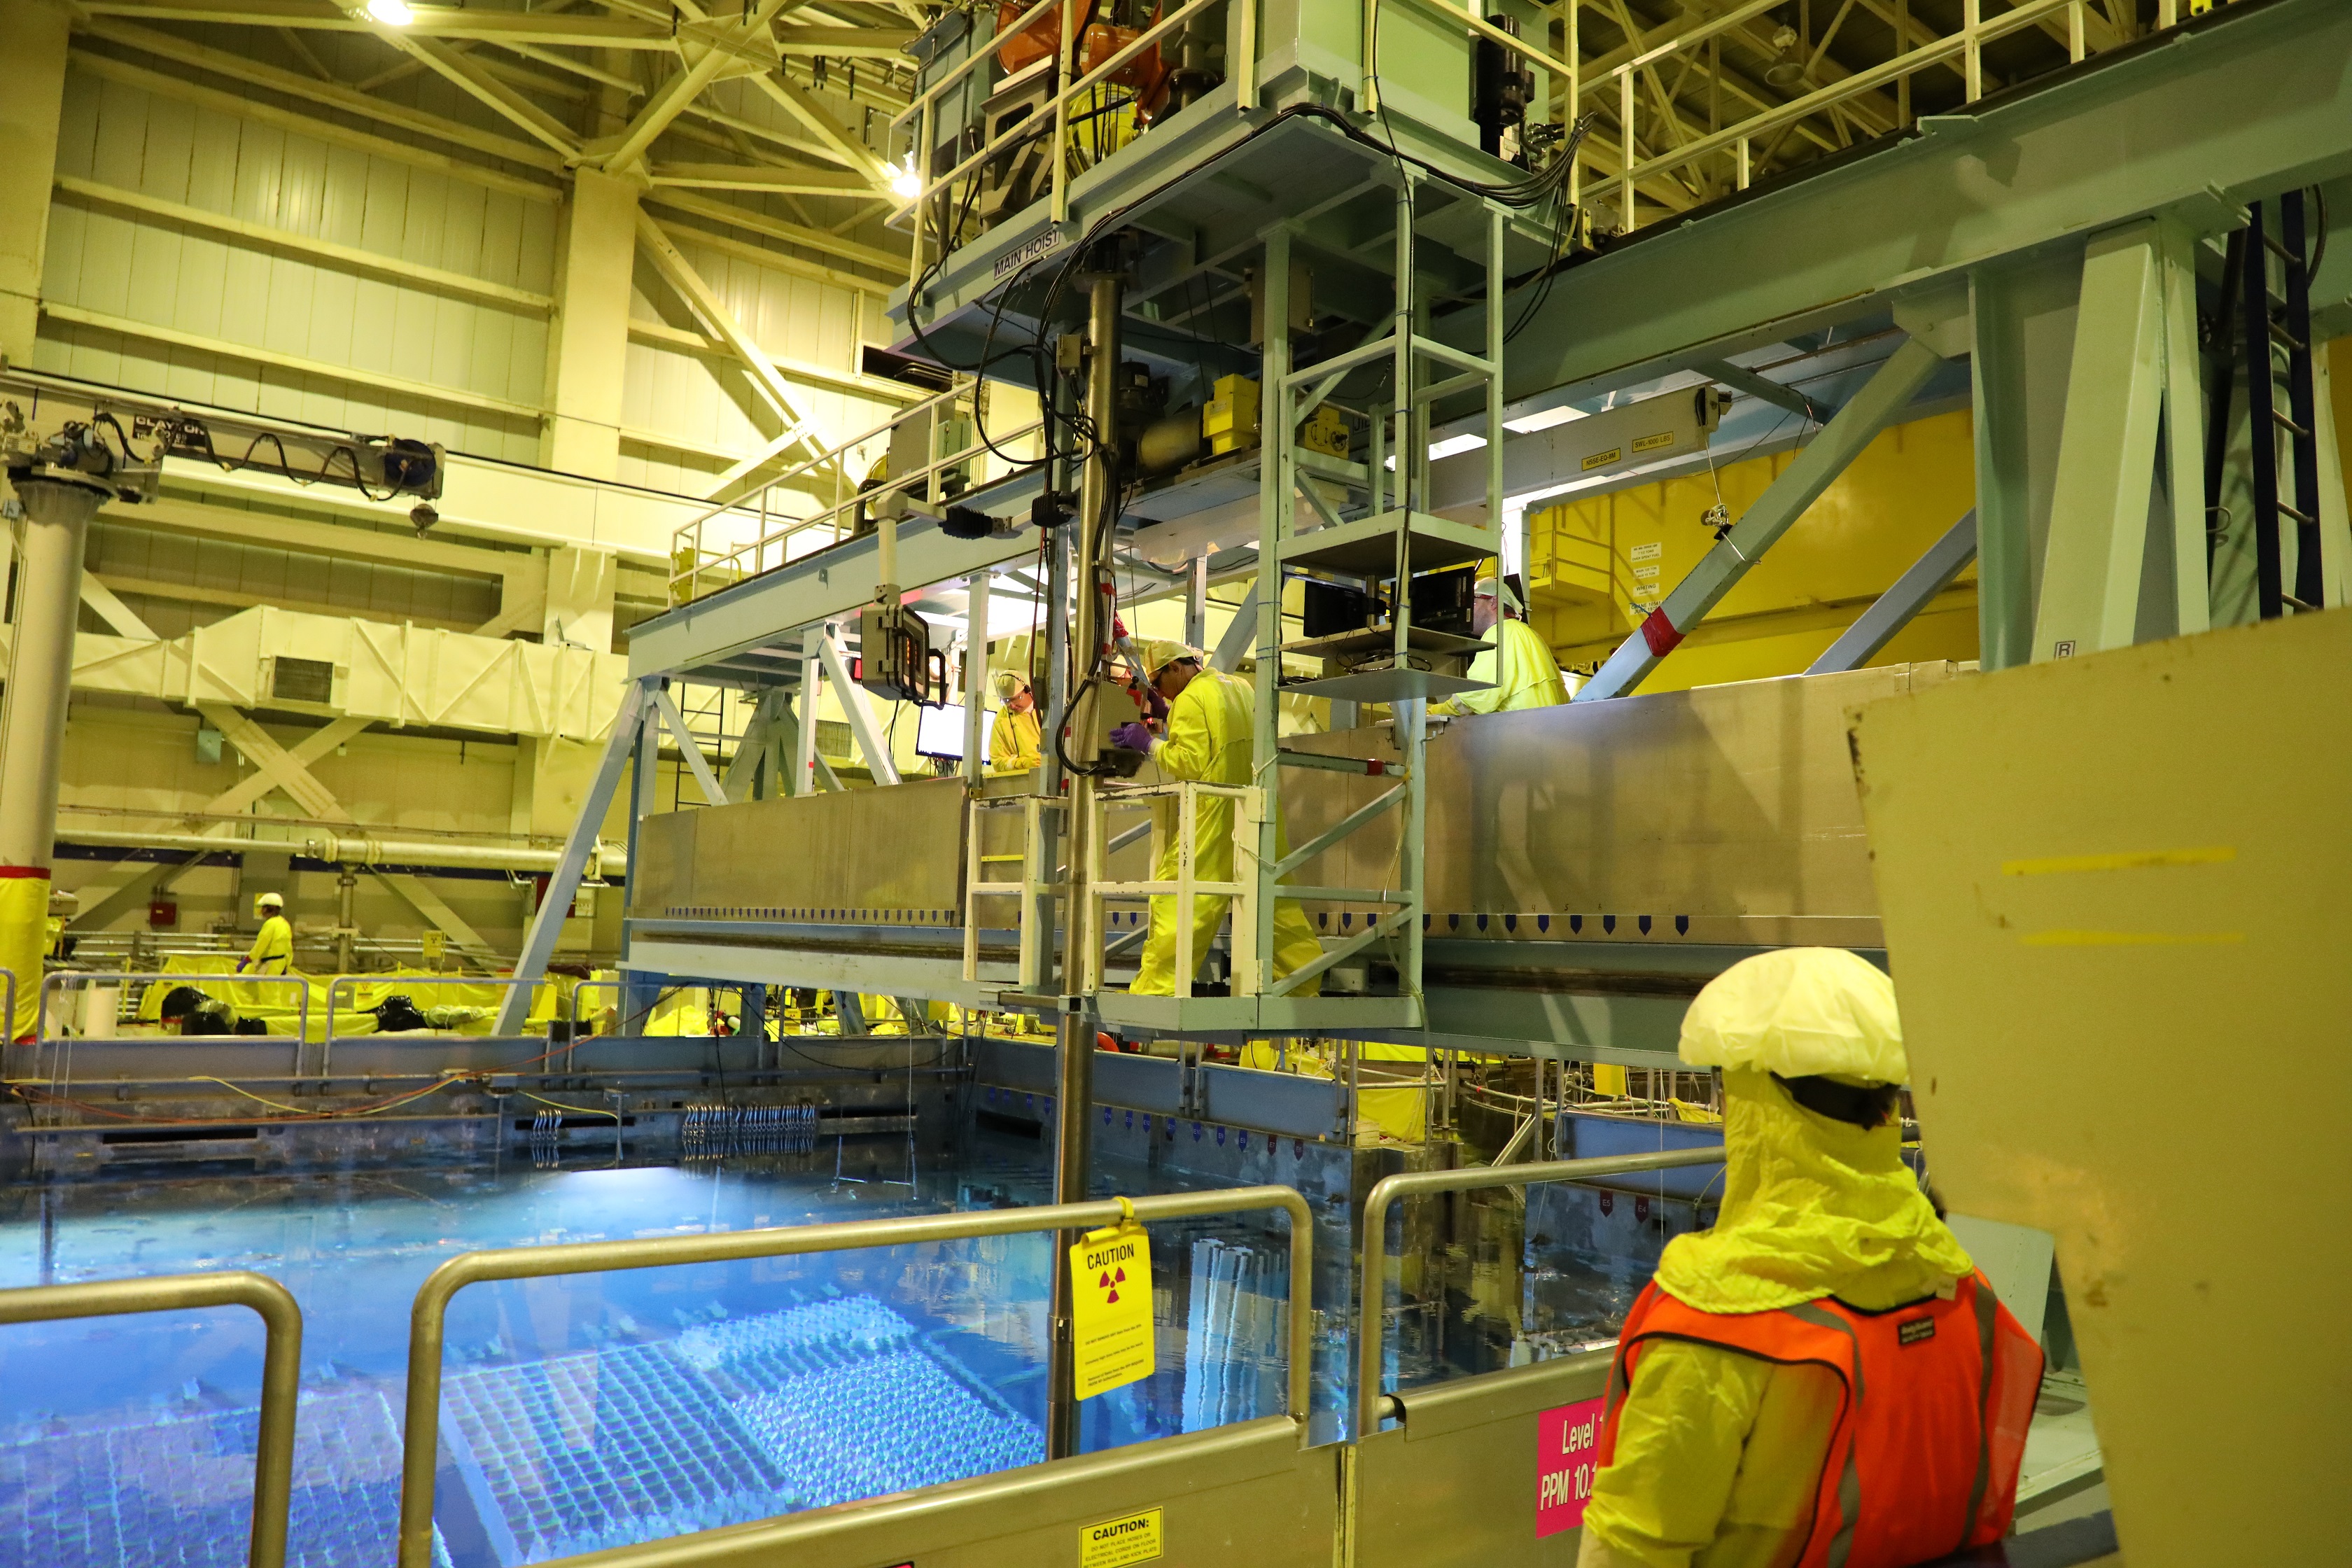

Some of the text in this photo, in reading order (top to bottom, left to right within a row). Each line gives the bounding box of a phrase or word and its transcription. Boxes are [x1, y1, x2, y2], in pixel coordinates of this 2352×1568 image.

[995, 229, 1058, 276] MAIN HOIST
[1635, 438, 1659, 448] SWL-1000
[2059, 643, 2071, 656] R
[1088, 1243, 1134, 1270] CAUTION
[1562, 1413, 1595, 1455] Level
[1540, 1469, 1569, 1511] PPM
[1093, 1518, 1149, 1541] CAUTION:
